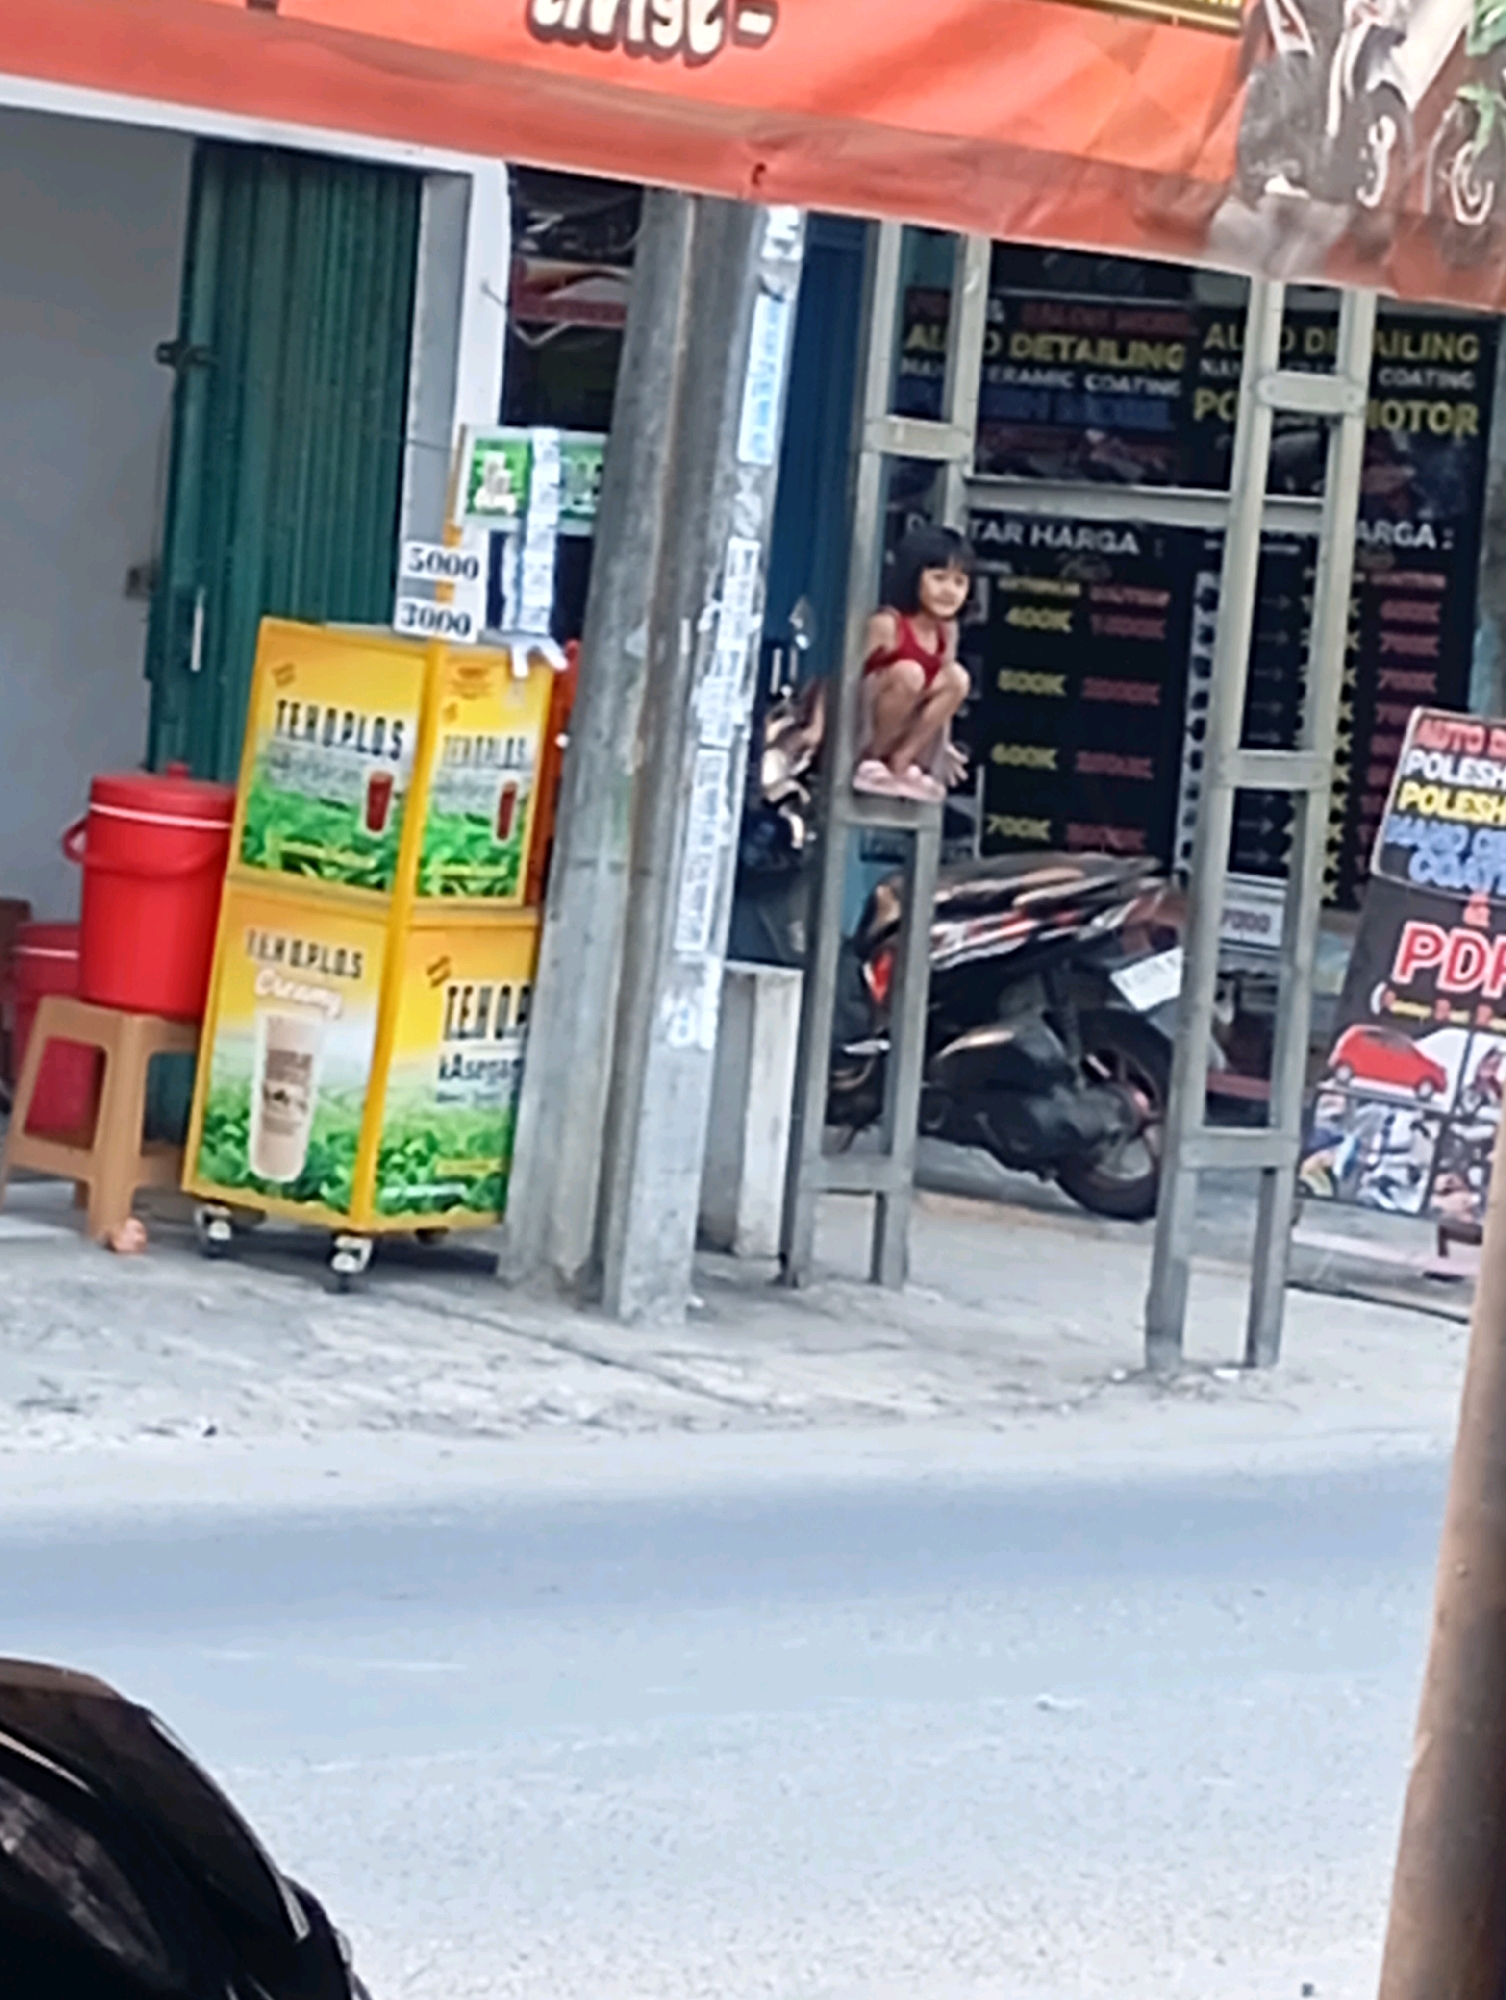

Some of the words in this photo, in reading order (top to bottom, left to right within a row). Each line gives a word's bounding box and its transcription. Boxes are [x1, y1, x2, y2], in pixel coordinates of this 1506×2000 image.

[905, 323, 1003, 356] AUO
[1009, 332, 1185, 371] DETAILING
[1203, 322, 1297, 351] AUO
[988, 367, 1075, 389] ERAMIC
[1084, 374, 1182, 397] COATING
[1379, 367, 1475, 390] COATING
[1030, 523, 1140, 556] HARGA
[1355, 518, 1437, 550] ARGA
[408, 547, 480, 580] 5000
[400, 601, 472, 638] 3000
